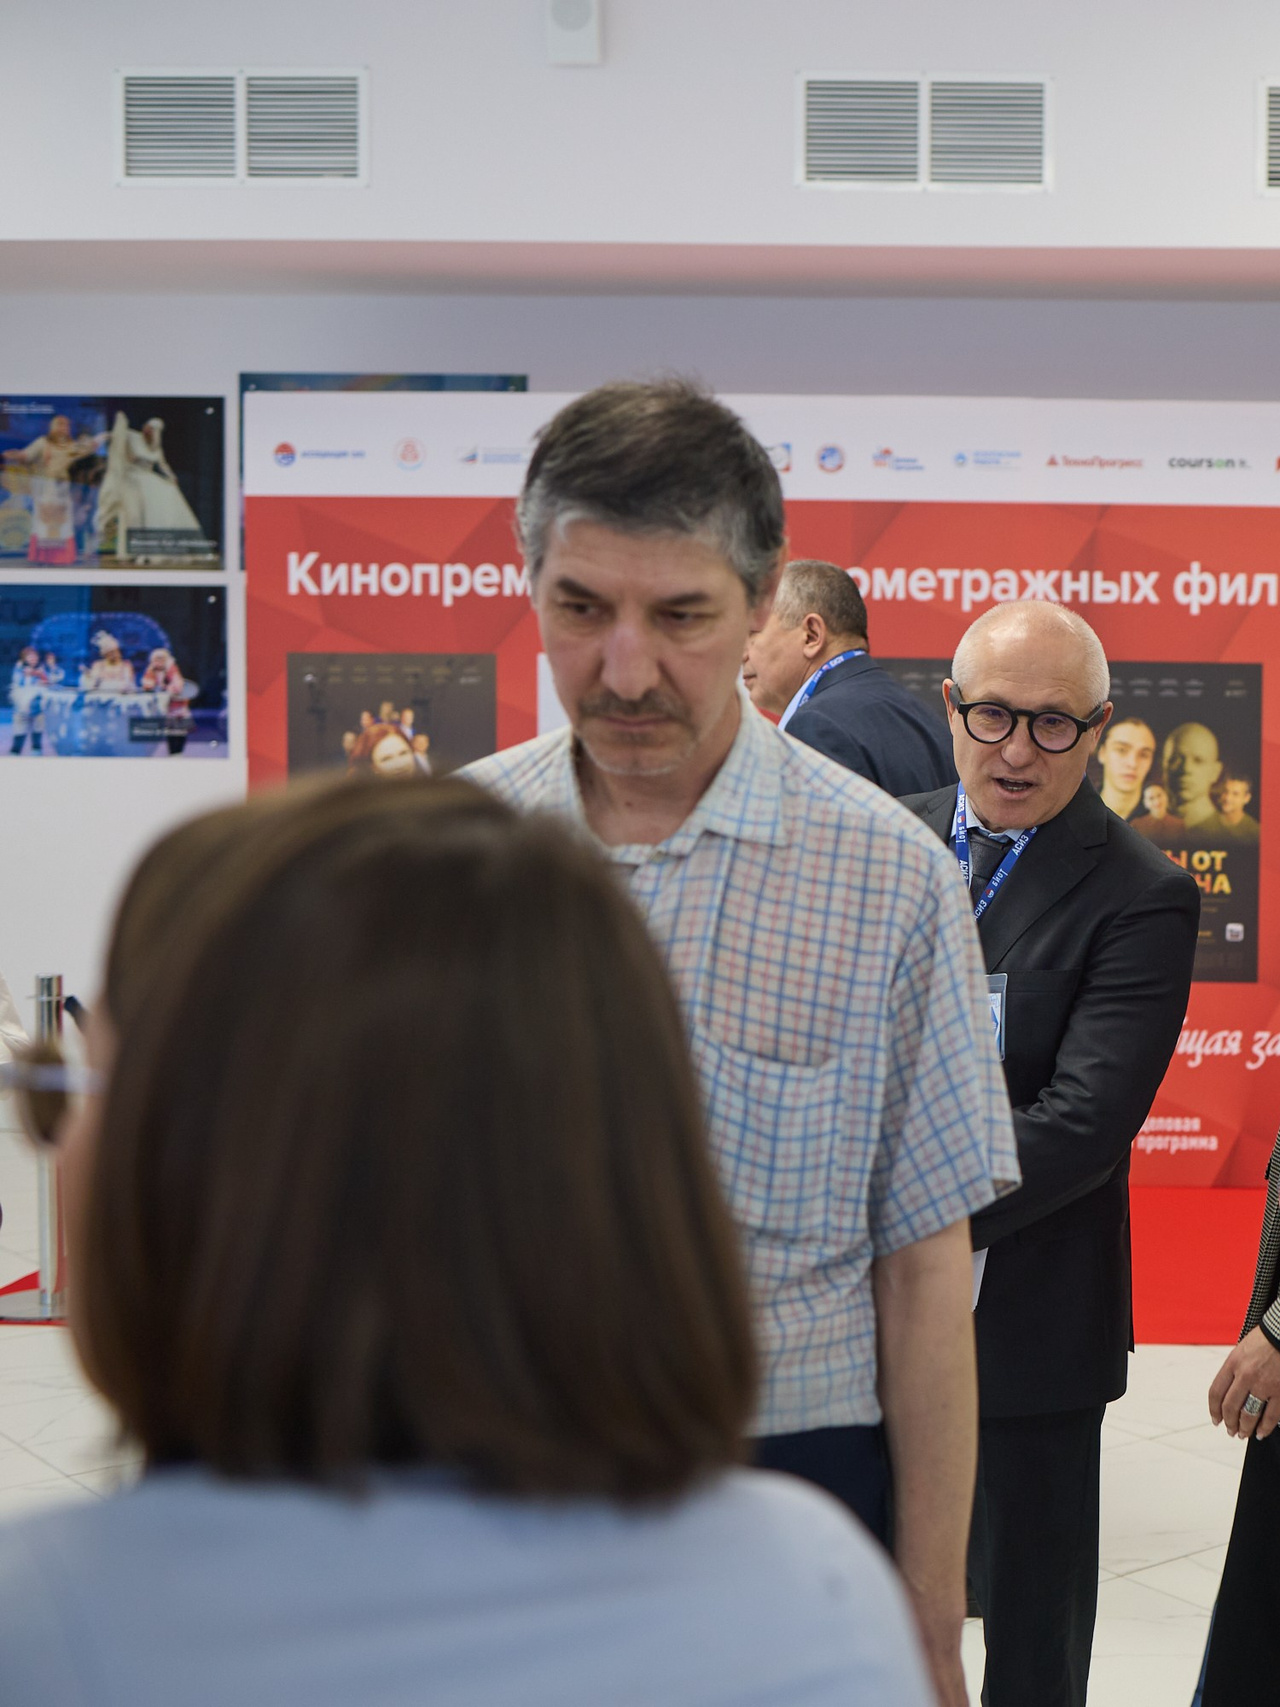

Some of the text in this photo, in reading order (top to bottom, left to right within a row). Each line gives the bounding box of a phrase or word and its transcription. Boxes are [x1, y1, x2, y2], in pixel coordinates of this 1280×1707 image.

[287, 552, 532, 606] Кинопрем
[845, 565, 1160, 612] ометражных
[1011, 834, 1029, 855] АСИЗ
[1191, 850, 1228, 872] ОТ
